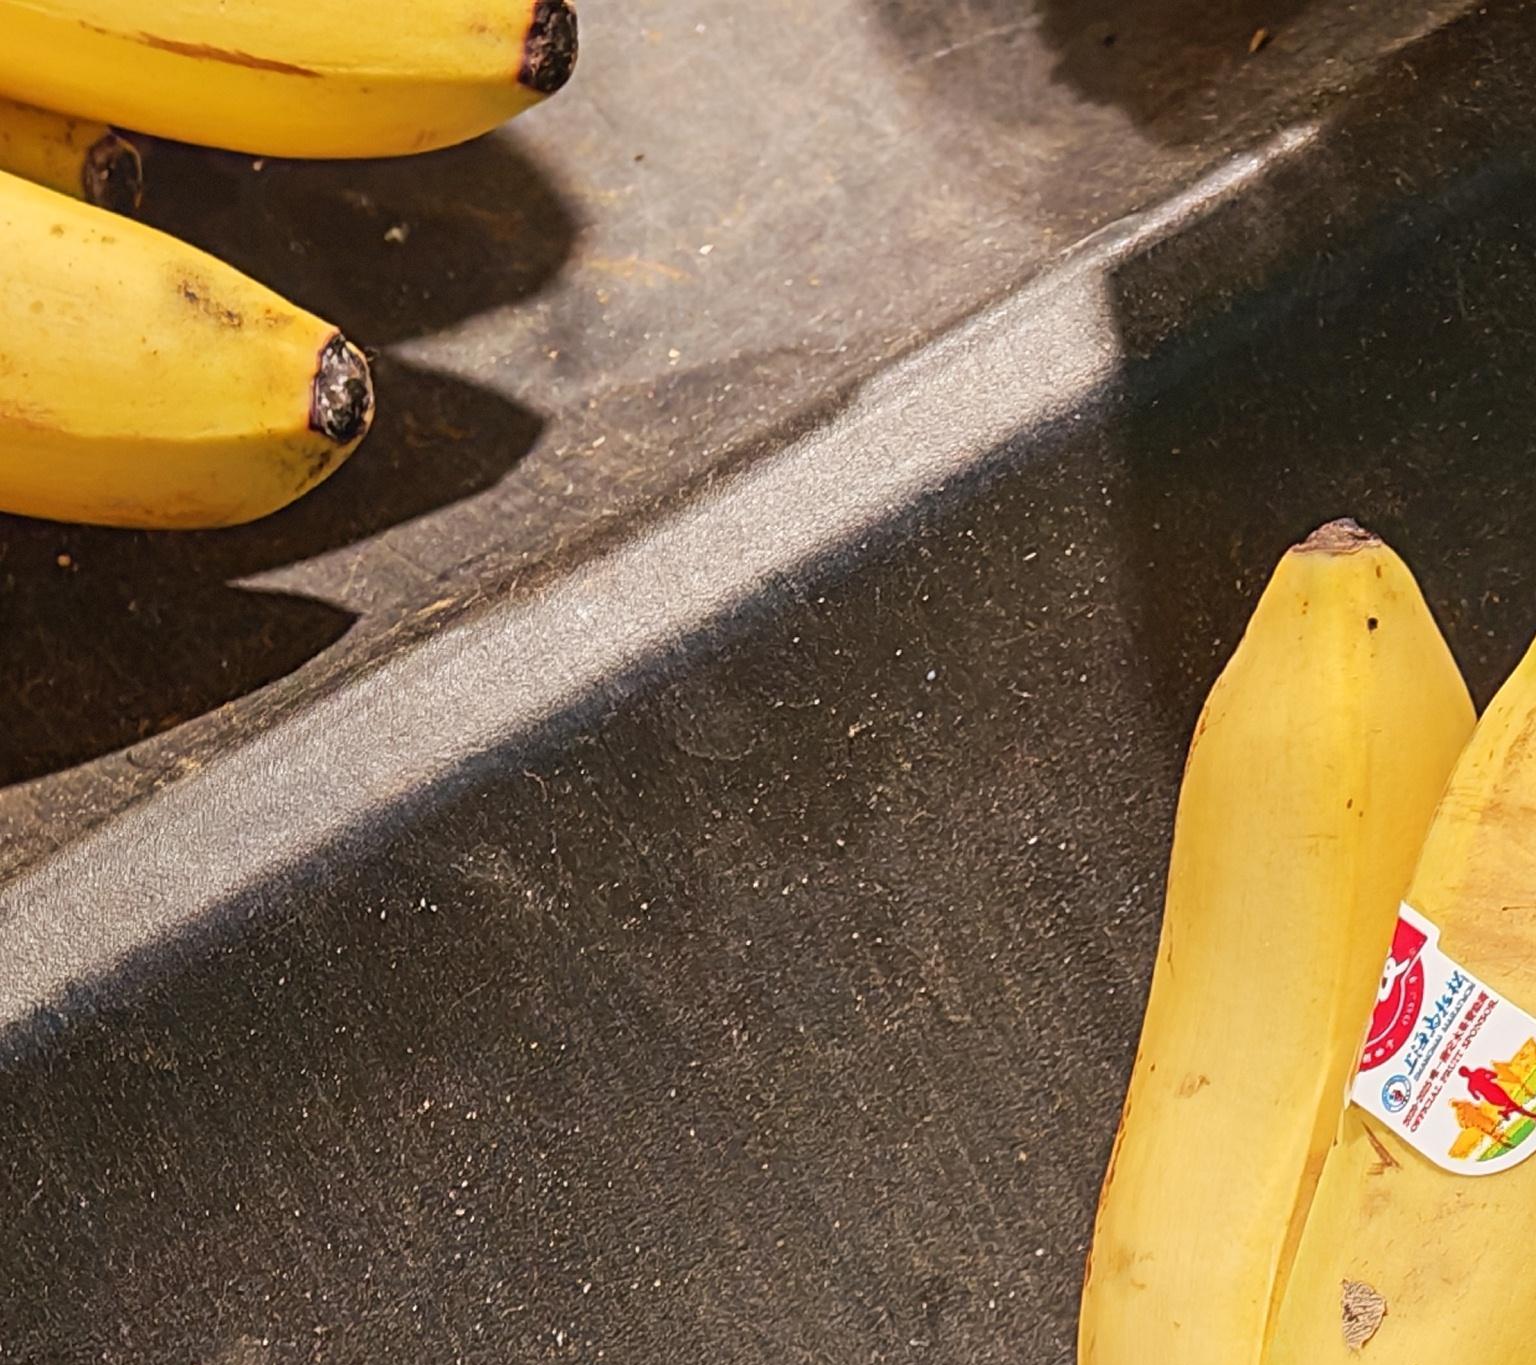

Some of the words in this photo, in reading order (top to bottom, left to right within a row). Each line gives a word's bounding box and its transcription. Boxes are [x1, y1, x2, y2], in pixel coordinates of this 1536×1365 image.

[1407, 1083, 1443, 1133] OFFICIAL
[1438, 1048, 1464, 1083] FRUIT
[1460, 996, 1498, 1049] SPONSOR
